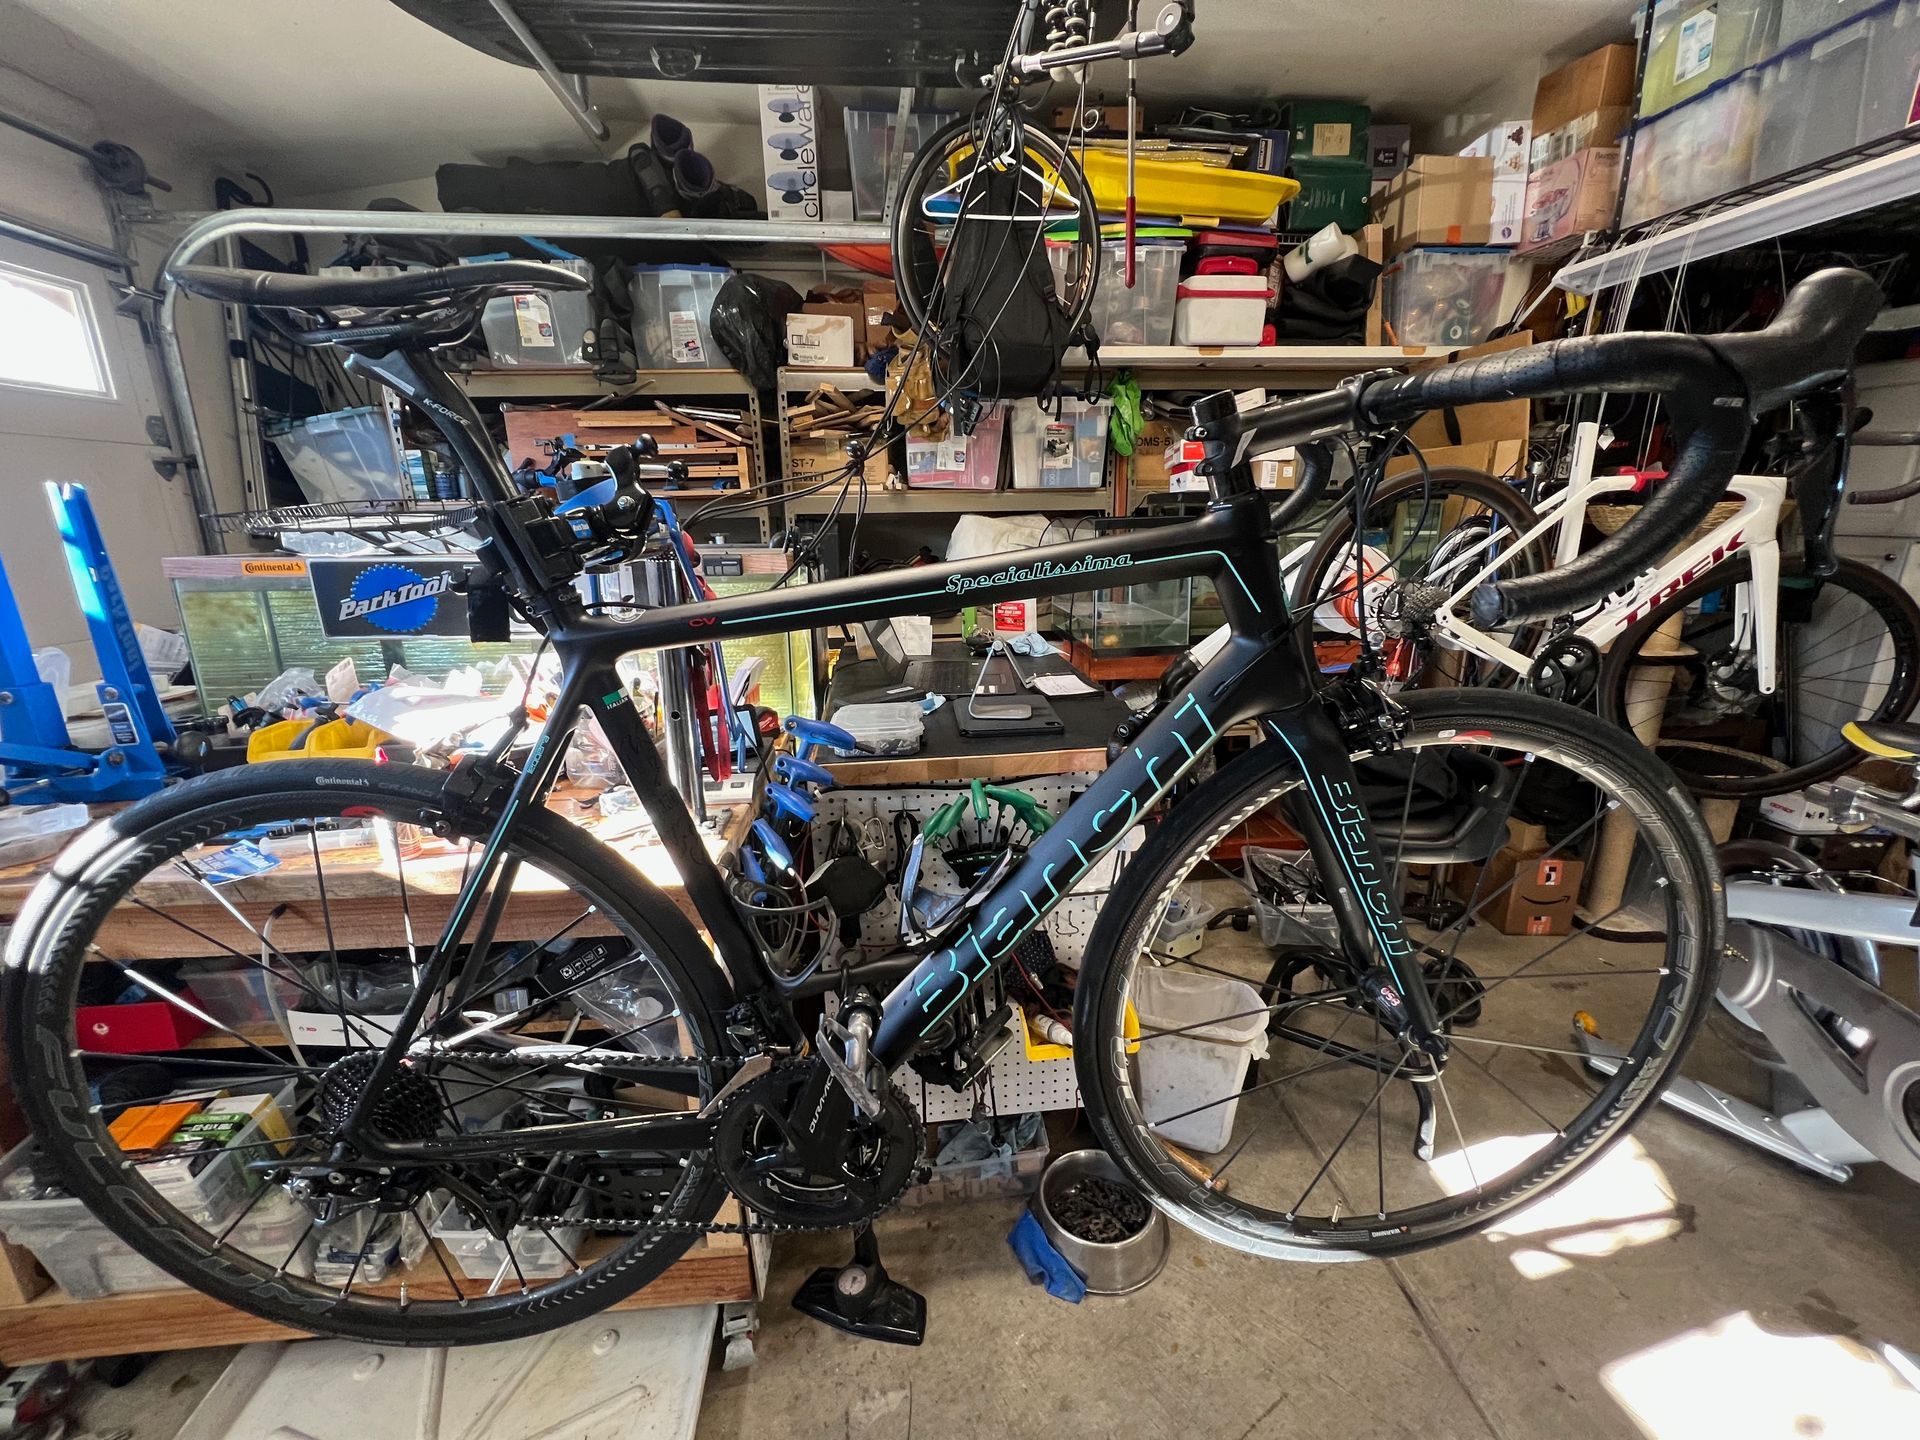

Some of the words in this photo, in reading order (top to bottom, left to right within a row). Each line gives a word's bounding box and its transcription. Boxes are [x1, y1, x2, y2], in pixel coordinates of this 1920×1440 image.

[797, 85, 820, 219] circleware
[422, 397, 471, 426] K-FORCE
[792, 458, 815, 468] ST-7
[245, 562, 294, 574] Continental
[945, 552, 1134, 595] Specialissima
[1615, 528, 1747, 627] TREK
[688, 616, 717, 628] CV
[916, 693, 1217, 1037] Bianchi
[1320, 774, 1414, 956] Bianchi
[1371, 1228, 1401, 1239] WARNING
